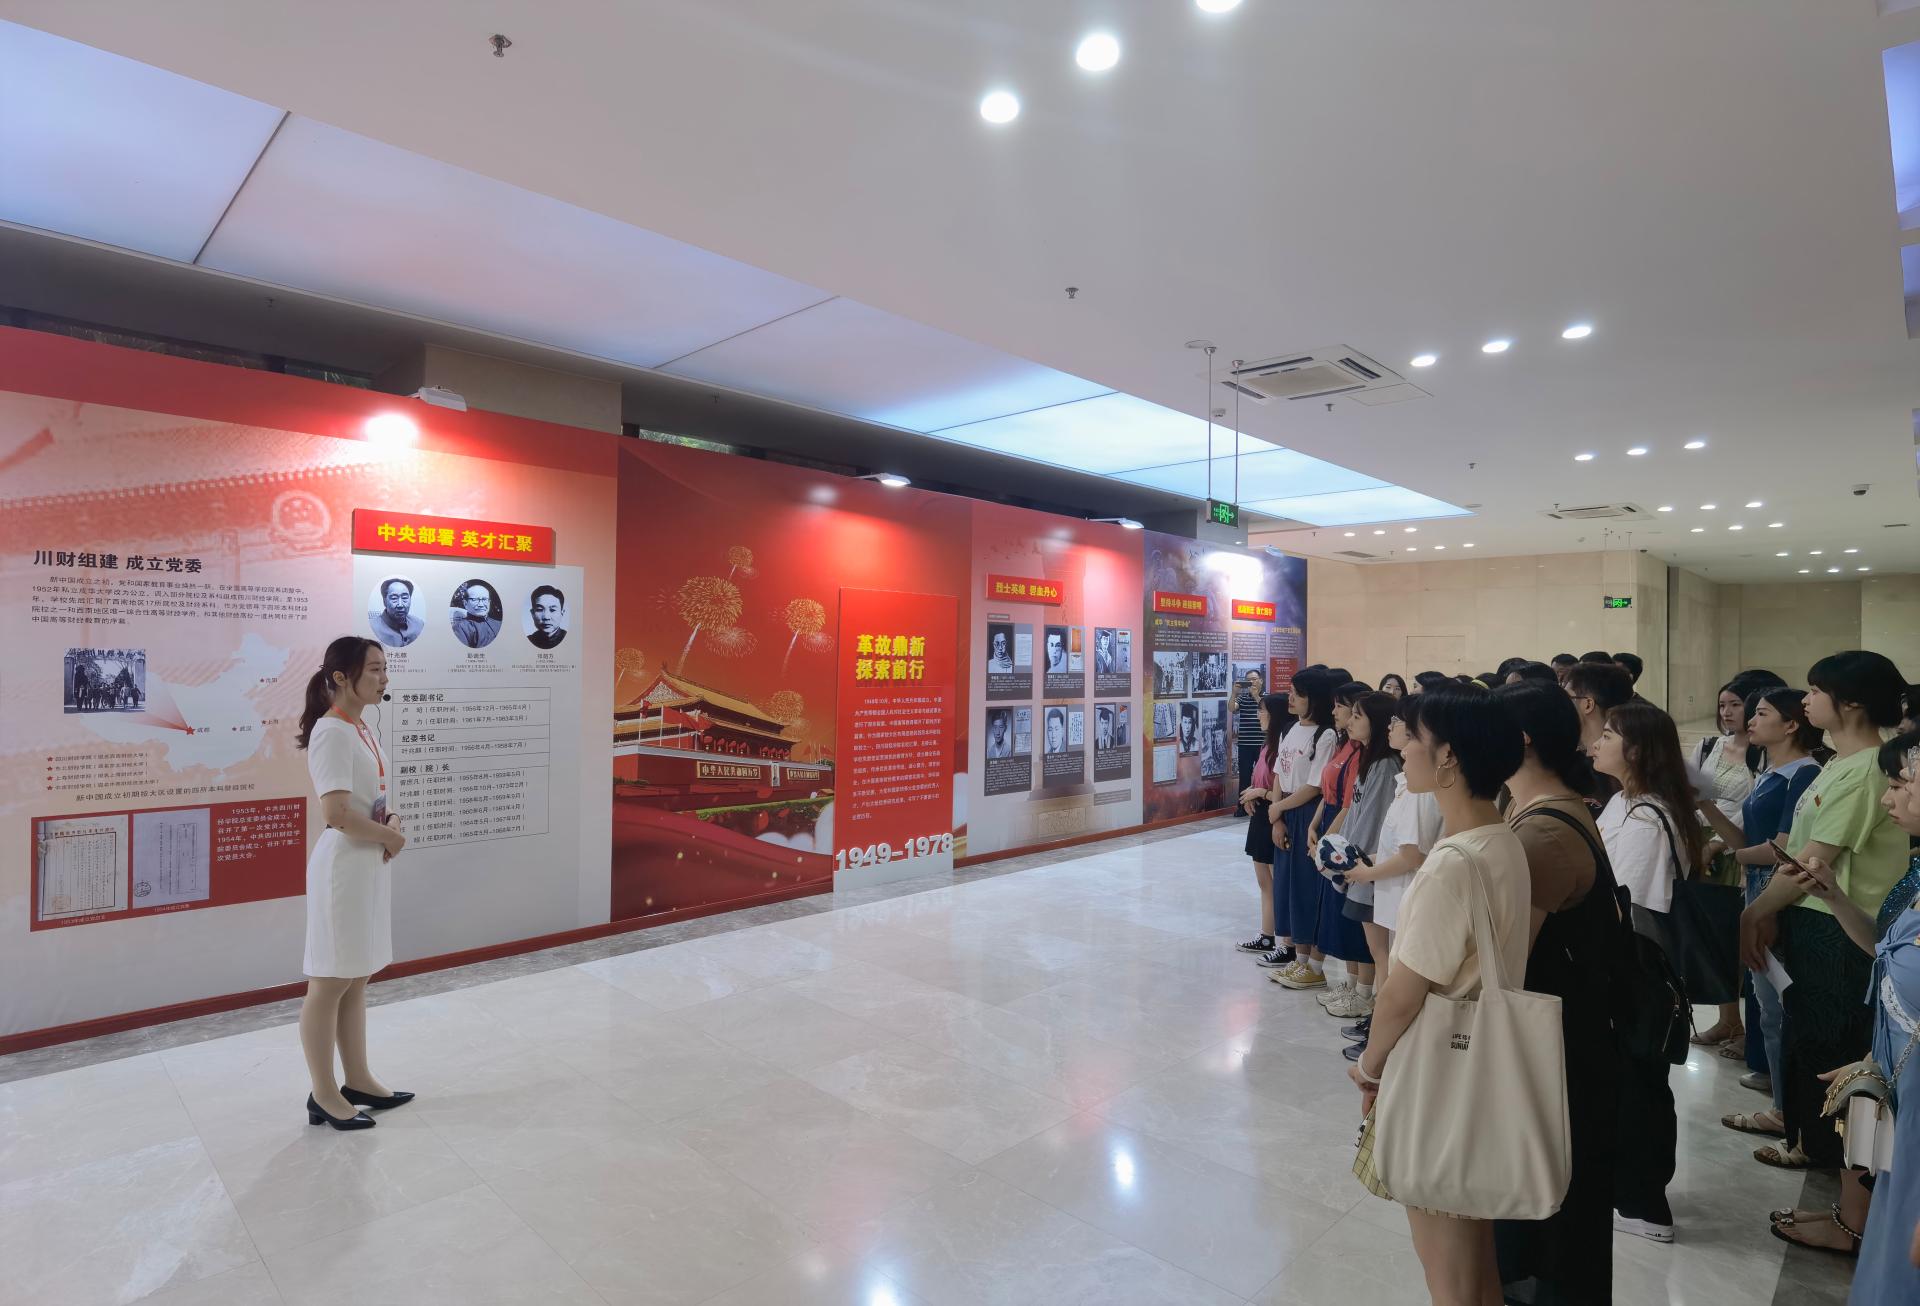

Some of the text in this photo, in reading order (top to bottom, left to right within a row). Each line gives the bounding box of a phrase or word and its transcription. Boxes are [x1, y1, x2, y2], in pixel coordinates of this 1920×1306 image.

[377, 523, 533, 552] 中央部署 英才汇聚
[33, 550, 203, 574] 川财组建 成立党委
[856, 634, 926, 657] 革故鼎新
[856, 658, 925, 680] 探索前行
[402, 693, 444, 702] 党委副书记
[402, 733, 435, 742] 纪委书记
[835, 832, 954, 872] 1949-1978
[1451, 1041, 1469, 1050] SUN
